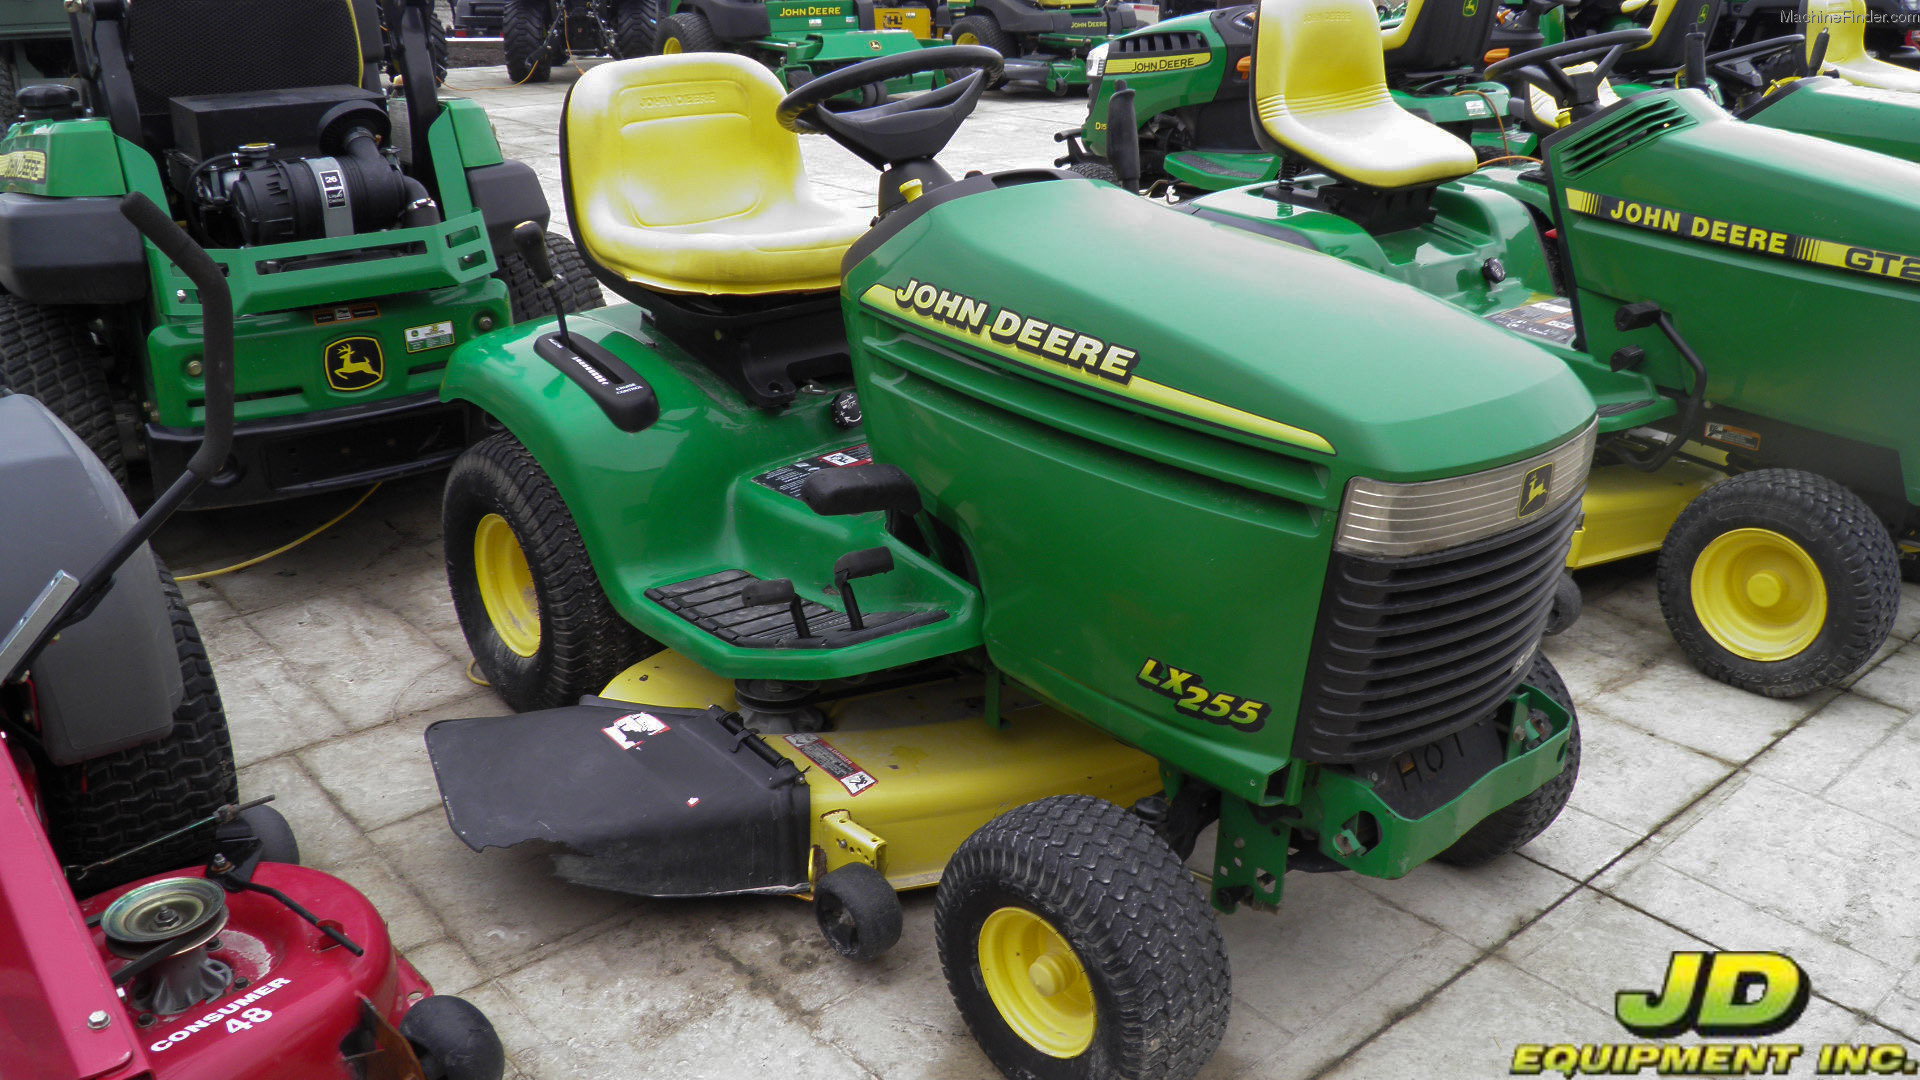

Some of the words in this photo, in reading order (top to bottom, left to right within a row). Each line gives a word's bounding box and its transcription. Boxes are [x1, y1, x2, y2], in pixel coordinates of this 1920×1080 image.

[780, 8, 806, 16] JOHN
[808, 7, 841, 15] DEERE
[1131, 62, 1158, 73] JOHN
[1159, 58, 1194, 70] DEERE
[324, 175, 338, 184] 26
[1610, 200, 1681, 232] JOHN
[1691, 215, 1788, 254] DEERE
[895, 278, 989, 331] JOHN
[990, 308, 1138, 380] DEERE
[150, 977, 292, 1052] CONSUMER
[225, 1007, 273, 1034] 48
